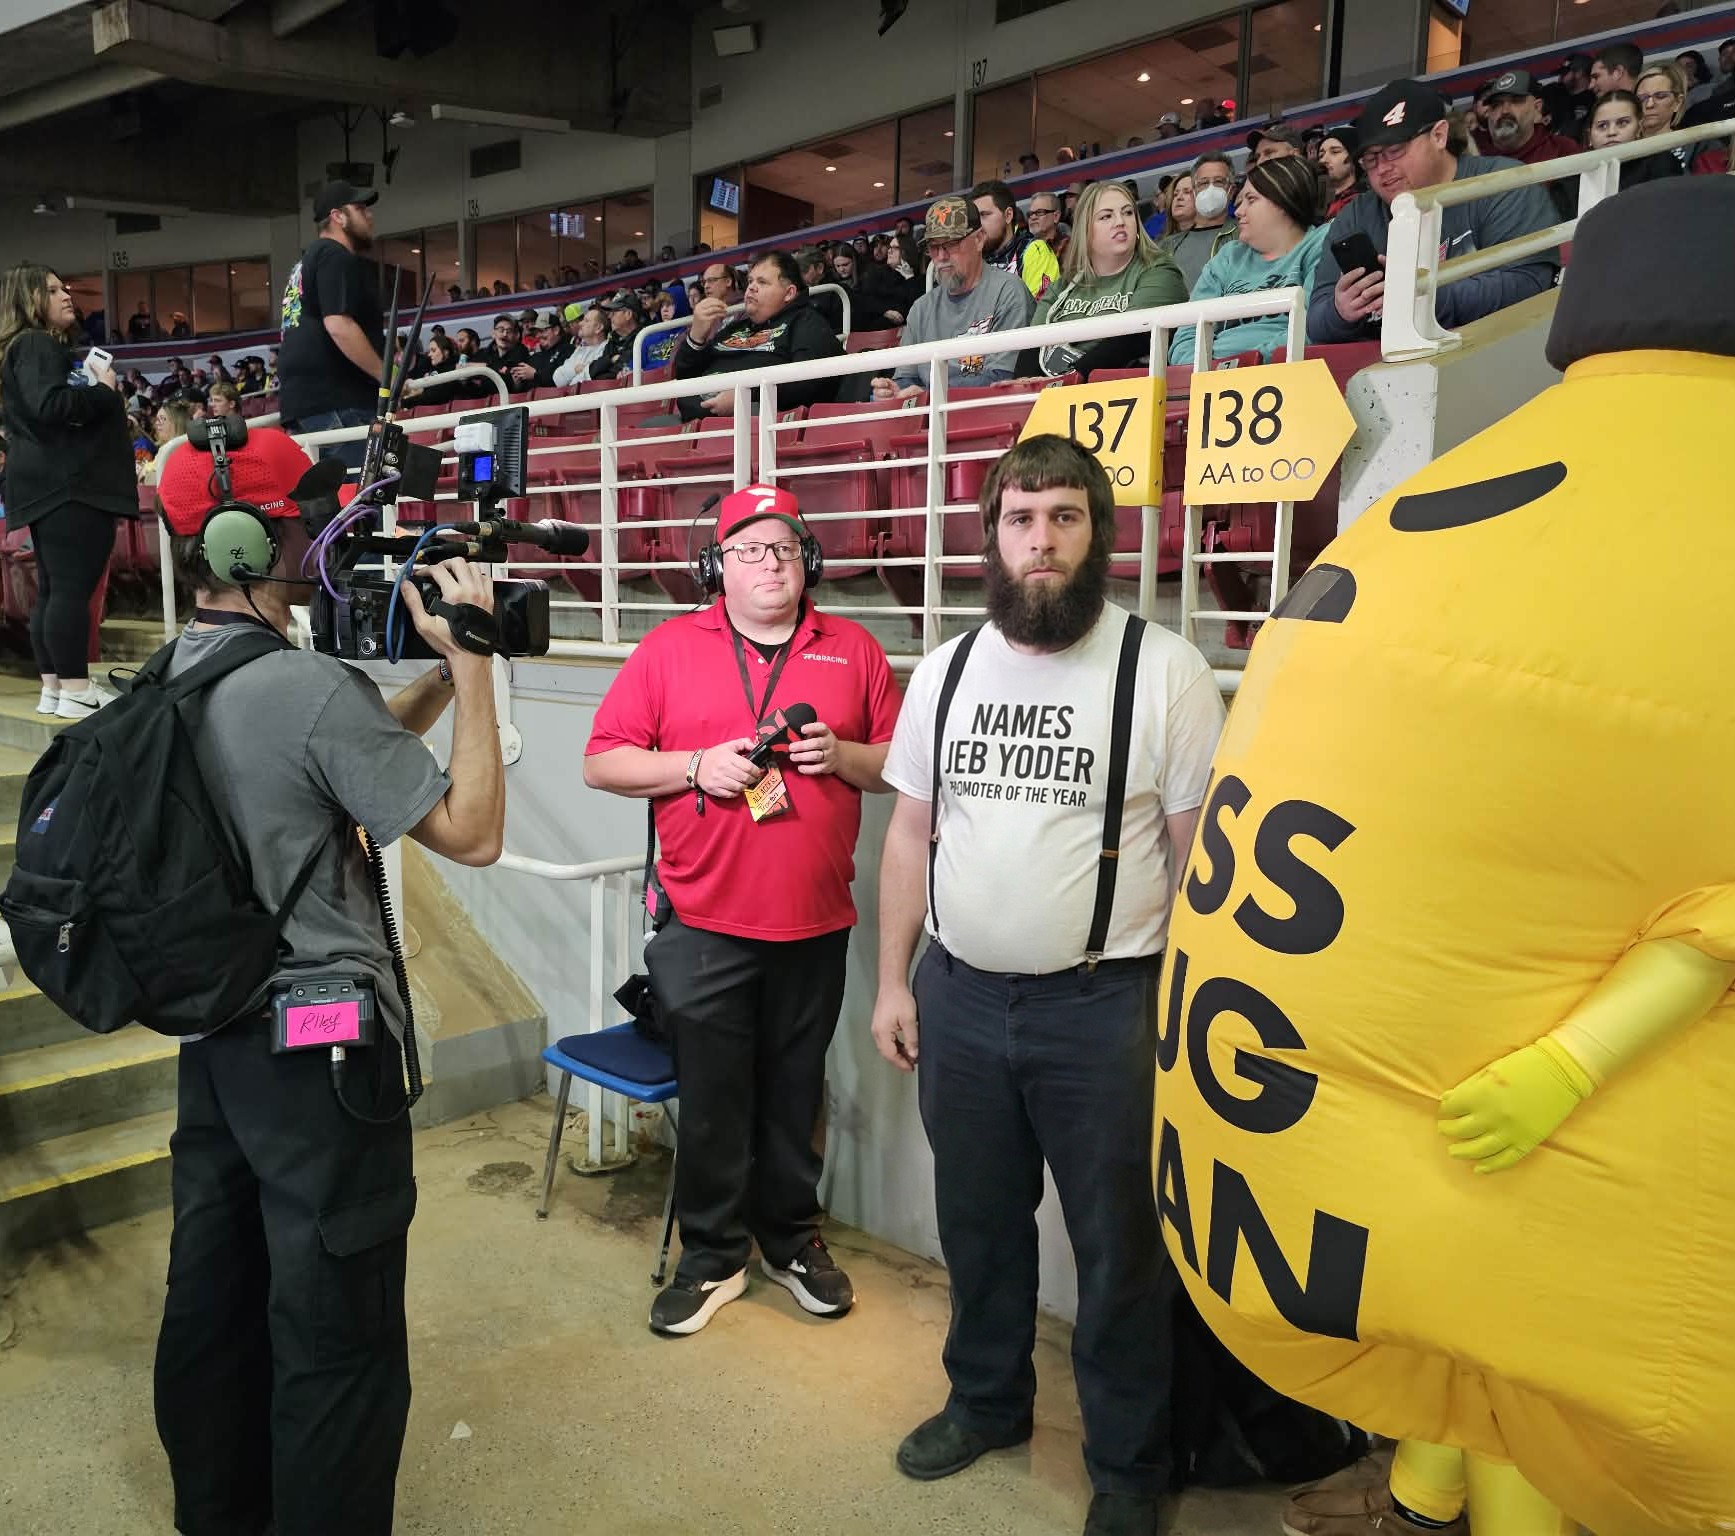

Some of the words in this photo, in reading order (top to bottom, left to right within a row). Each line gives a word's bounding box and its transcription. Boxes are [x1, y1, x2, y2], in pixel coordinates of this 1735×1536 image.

[972, 59, 988, 88] 137
[1382, 101, 1406, 126] 4
[1069, 397, 1138, 455] 137
[1200, 385, 1284, 449] 138
[1199, 463, 1236, 486] AA
[1242, 465, 1264, 483] to
[1270, 457, 1316, 482] OO
[260, 500, 285, 511] ACING
[971, 703, 1074, 740] NAMES
[945, 740, 988, 775] JEB
[998, 743, 1095, 785] YODER
[1005, 785, 1023, 801] OF
[1025, 786, 1049, 804] THE
[1052, 788, 1087, 808] YEAR
[1179, 766, 1357, 955] SS
